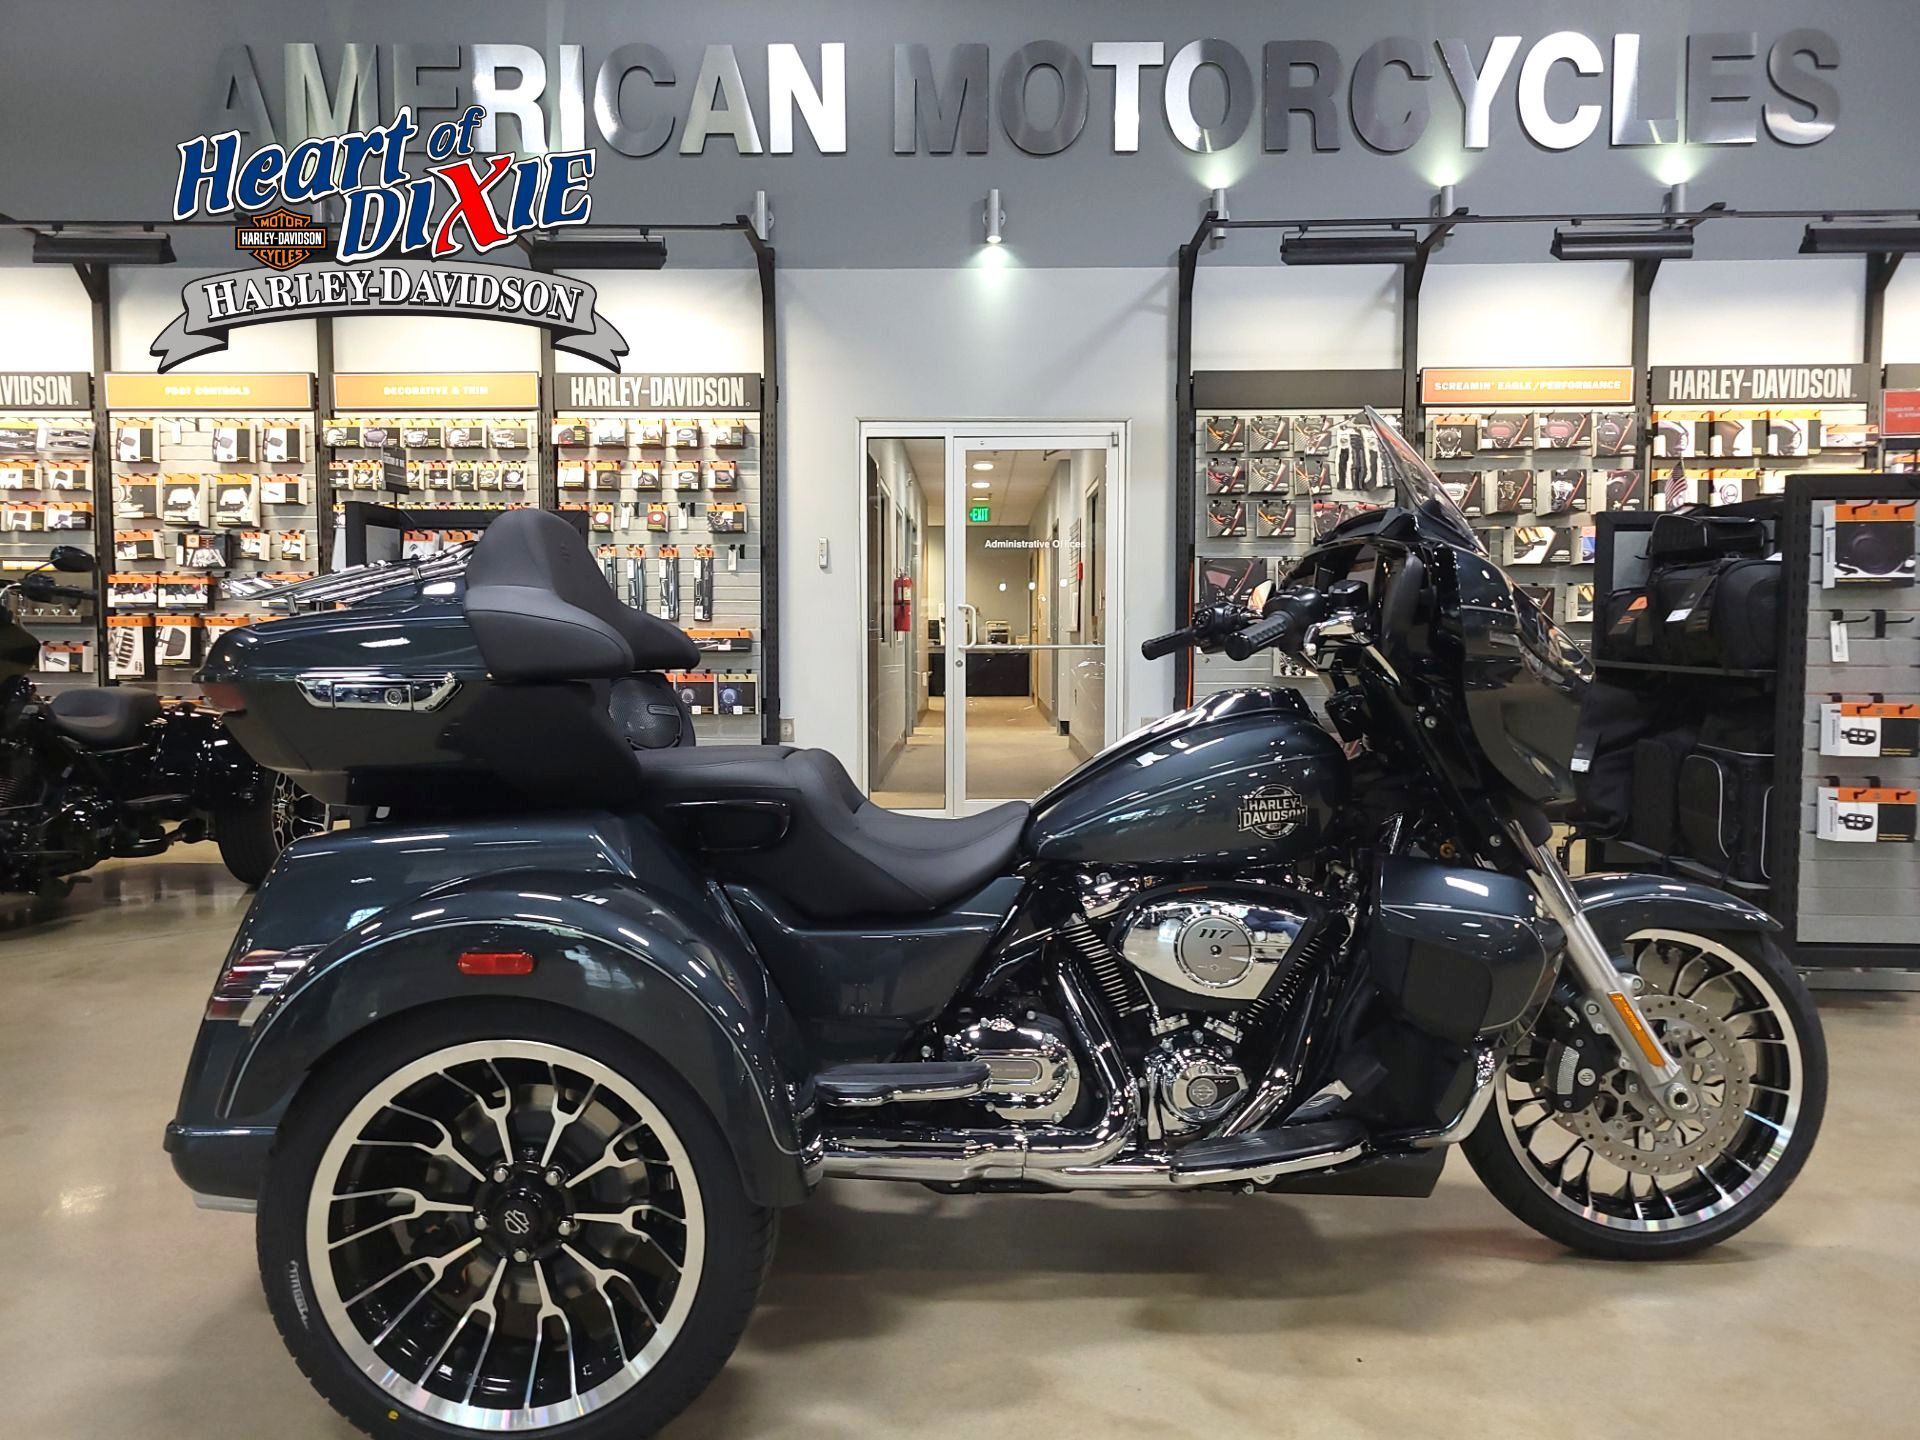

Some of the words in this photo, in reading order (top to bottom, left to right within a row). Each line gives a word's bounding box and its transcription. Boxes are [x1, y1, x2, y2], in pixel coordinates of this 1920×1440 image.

[214, 42, 848, 156] AMERICAN
[892, 31, 1842, 155] MOTORCYCLES
[570, 376, 744, 407] HARLEY-DAVIDSON
[1668, 368, 1852, 400] HARLEY-DAVIDSON
[972, 507, 989, 522] EXIT
[984, 539, 1050, 549] Administrative
[1199, 928, 1234, 939] 117
